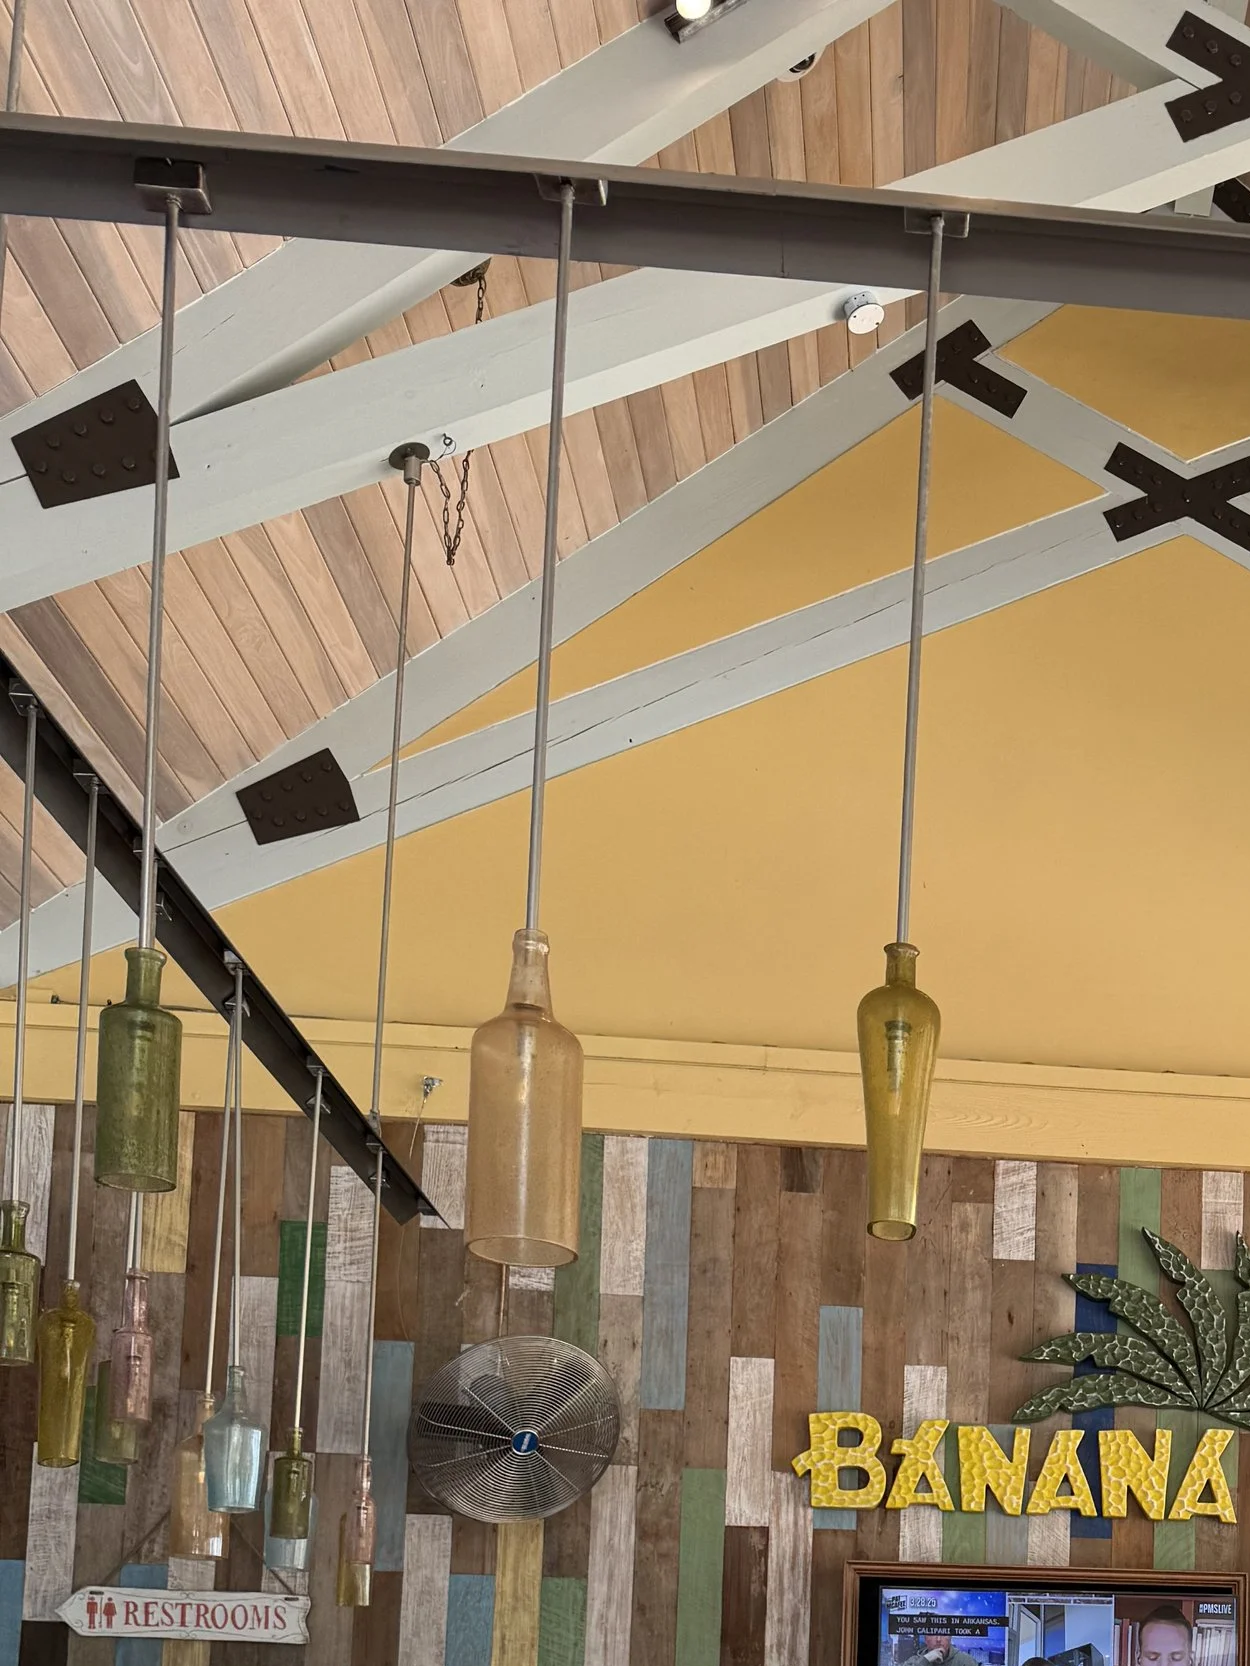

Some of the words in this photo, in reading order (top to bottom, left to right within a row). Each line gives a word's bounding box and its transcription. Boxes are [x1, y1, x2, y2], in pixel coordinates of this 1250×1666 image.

[791, 1411, 1237, 1525] BANANA
[124, 1600, 287, 1630] RESTROOMS
[1199, 1603, 1232, 1614] #PMSLIVE
